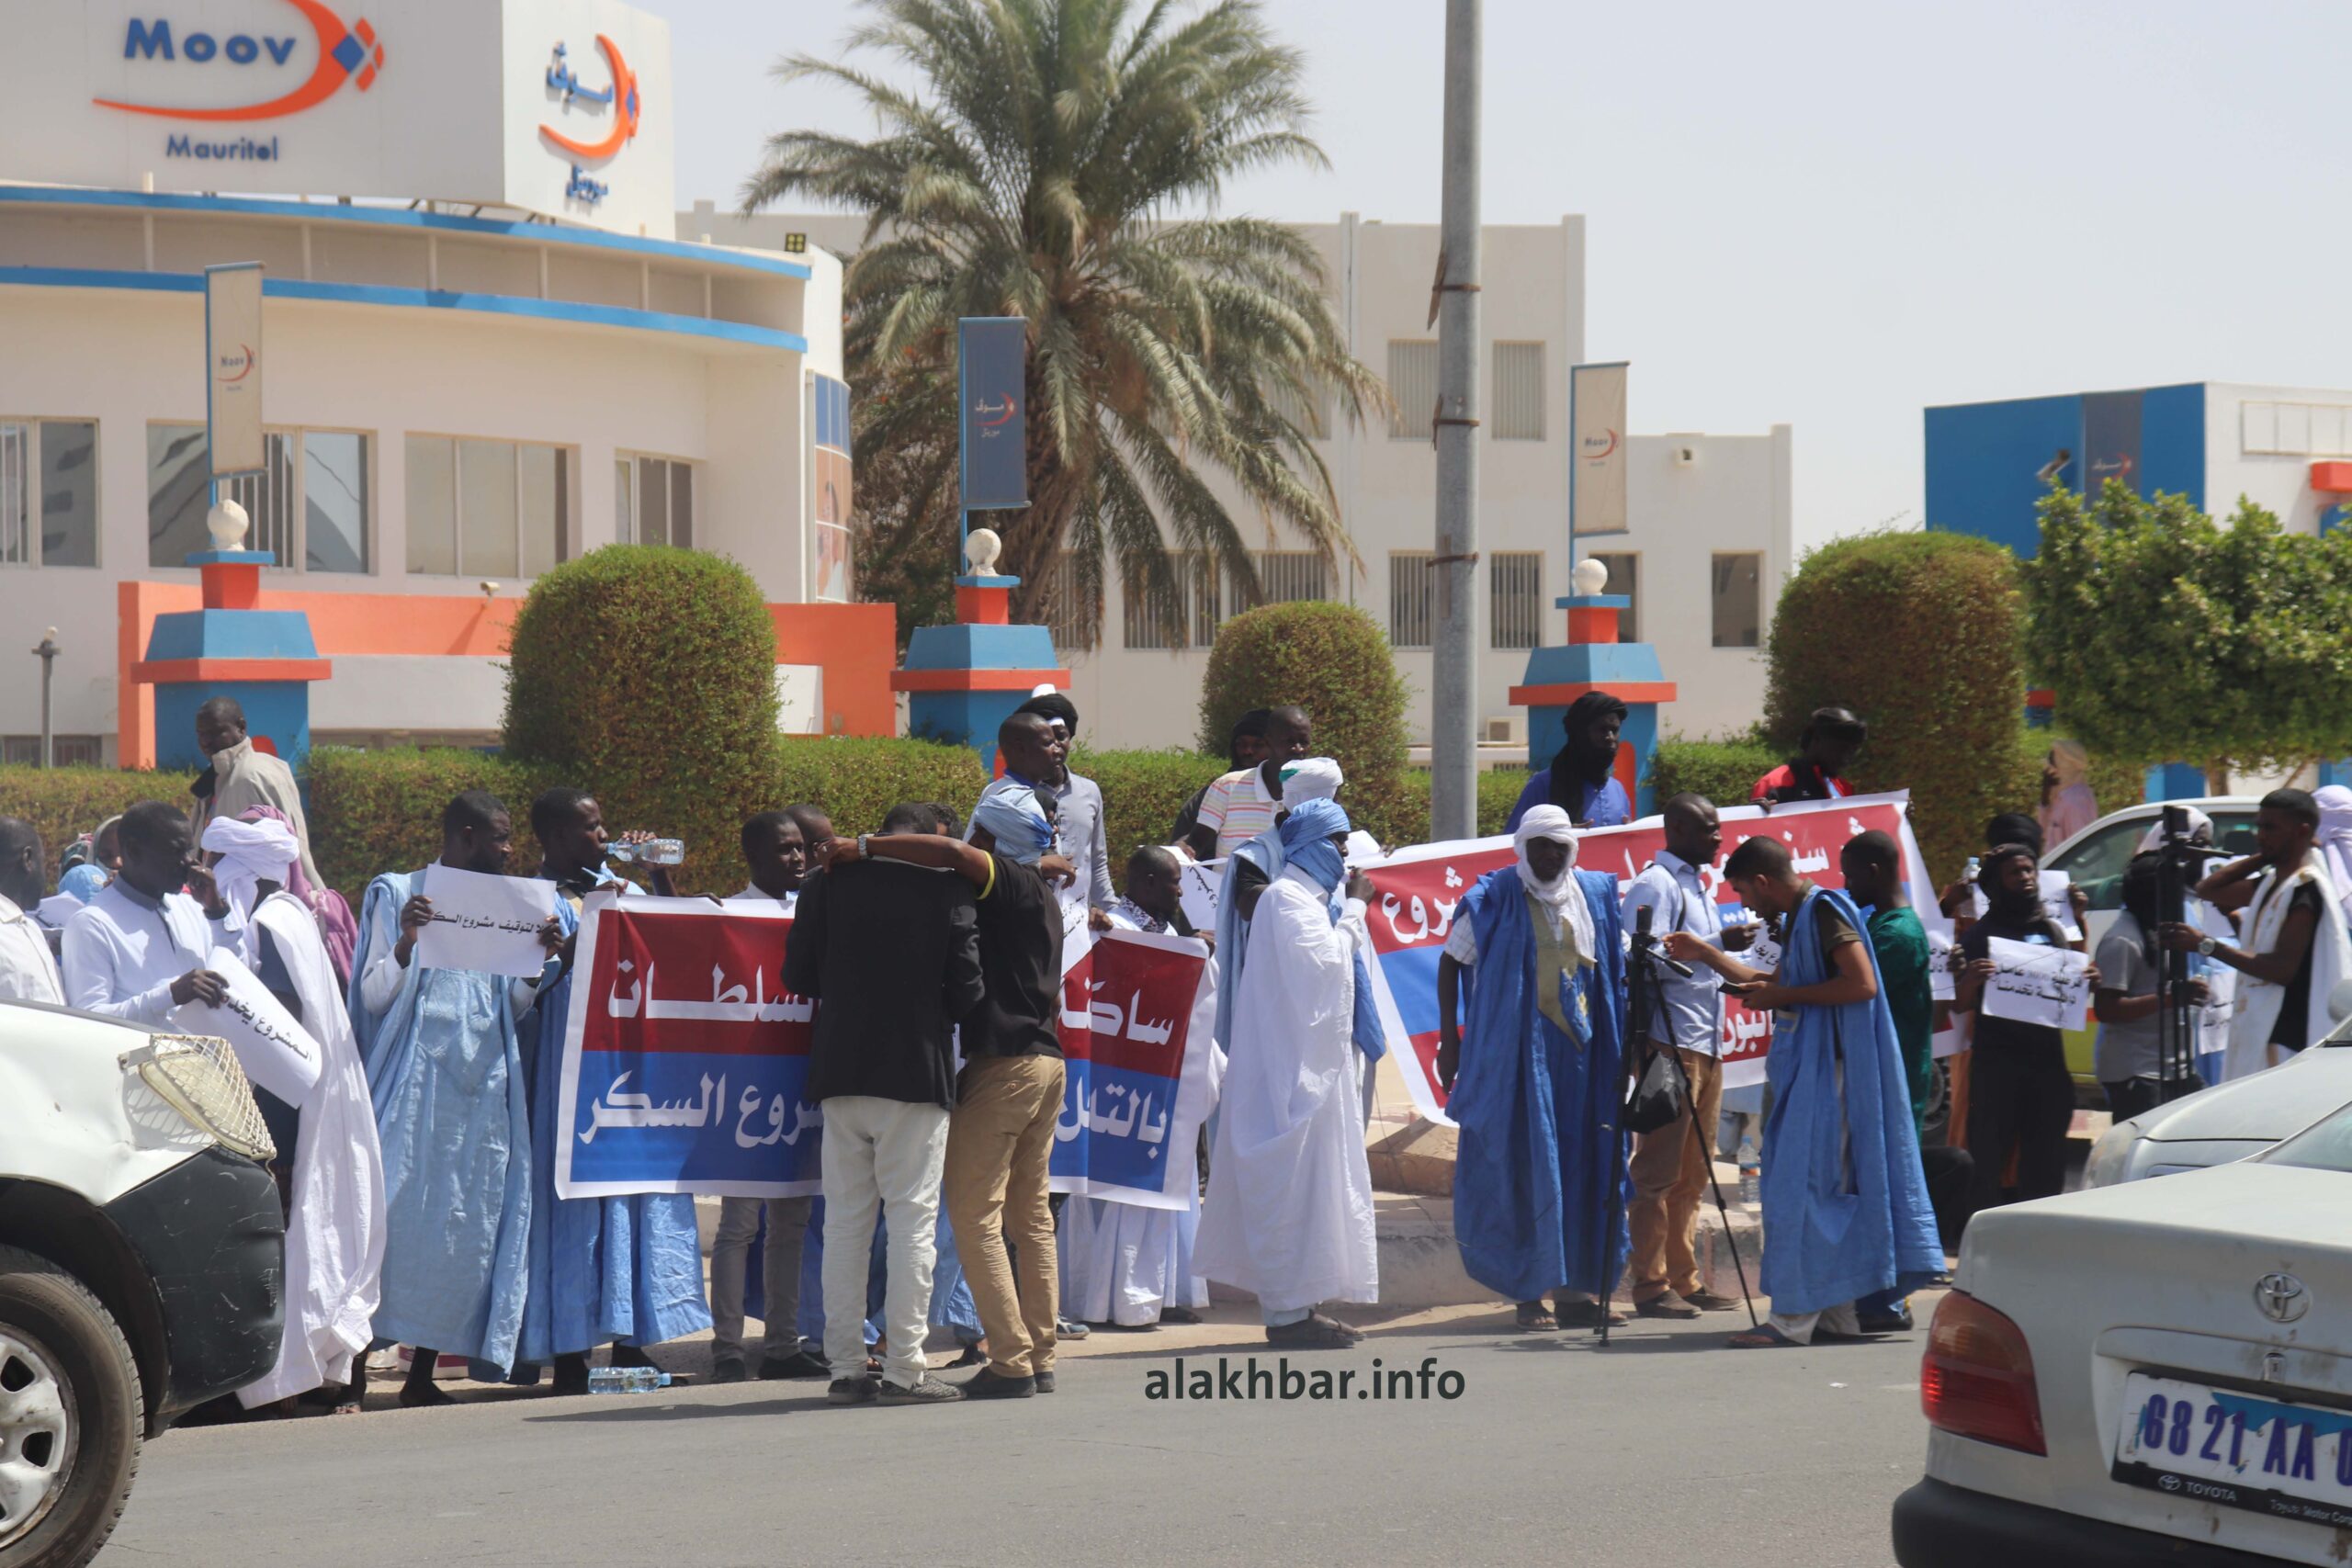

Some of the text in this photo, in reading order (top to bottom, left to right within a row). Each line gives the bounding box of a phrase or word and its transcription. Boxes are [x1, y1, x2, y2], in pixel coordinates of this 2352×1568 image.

[124, 18, 298, 65] Moov
[432, 910, 462, 924] السك
[461, 915, 495, 930] مشروع
[499, 919, 534, 935] لتوقيف
[253, 1015, 313, 1063] المشروع
[577, 1070, 727, 1145] السكر
[2263, 1416, 2315, 1482] AA
[2185, 1482, 2238, 1502] TOYOTA
[2302, 1505, 2331, 1521] Motor
